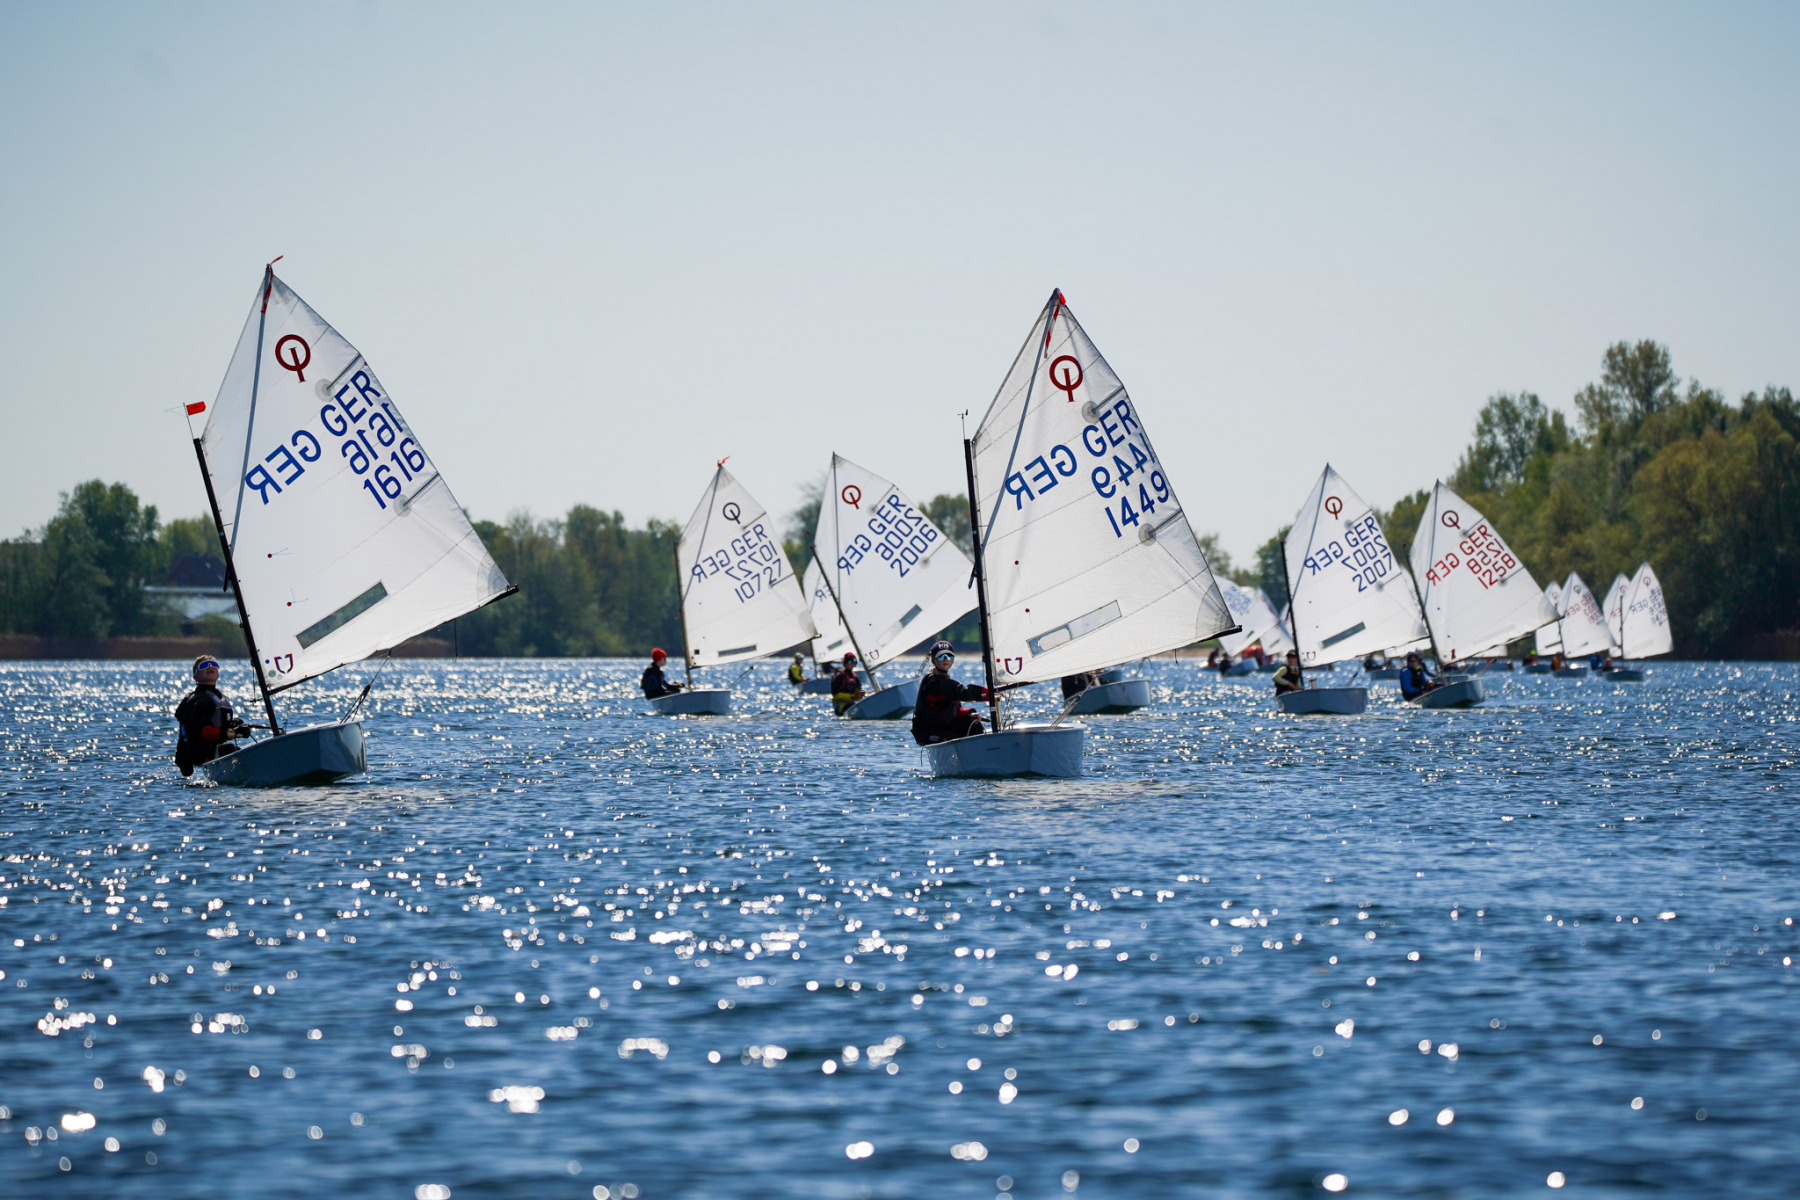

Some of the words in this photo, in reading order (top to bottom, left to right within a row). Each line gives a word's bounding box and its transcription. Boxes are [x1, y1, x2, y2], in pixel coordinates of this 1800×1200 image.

[320, 370, 381, 437] GER
[1082, 399, 1139, 457] GER
[363, 437, 425, 510] 1616
[868, 494, 906, 535] GER
[1105, 470, 1169, 538] 1449
[731, 523, 768, 556] GER
[890, 523, 938, 578] 2006
[1344, 516, 1379, 548] GER
[1459, 524, 1493, 556] GER
[734, 558, 782, 603] 10727
[1352, 551, 1392, 592] 2007
[1477, 553, 1516, 590] 1258
